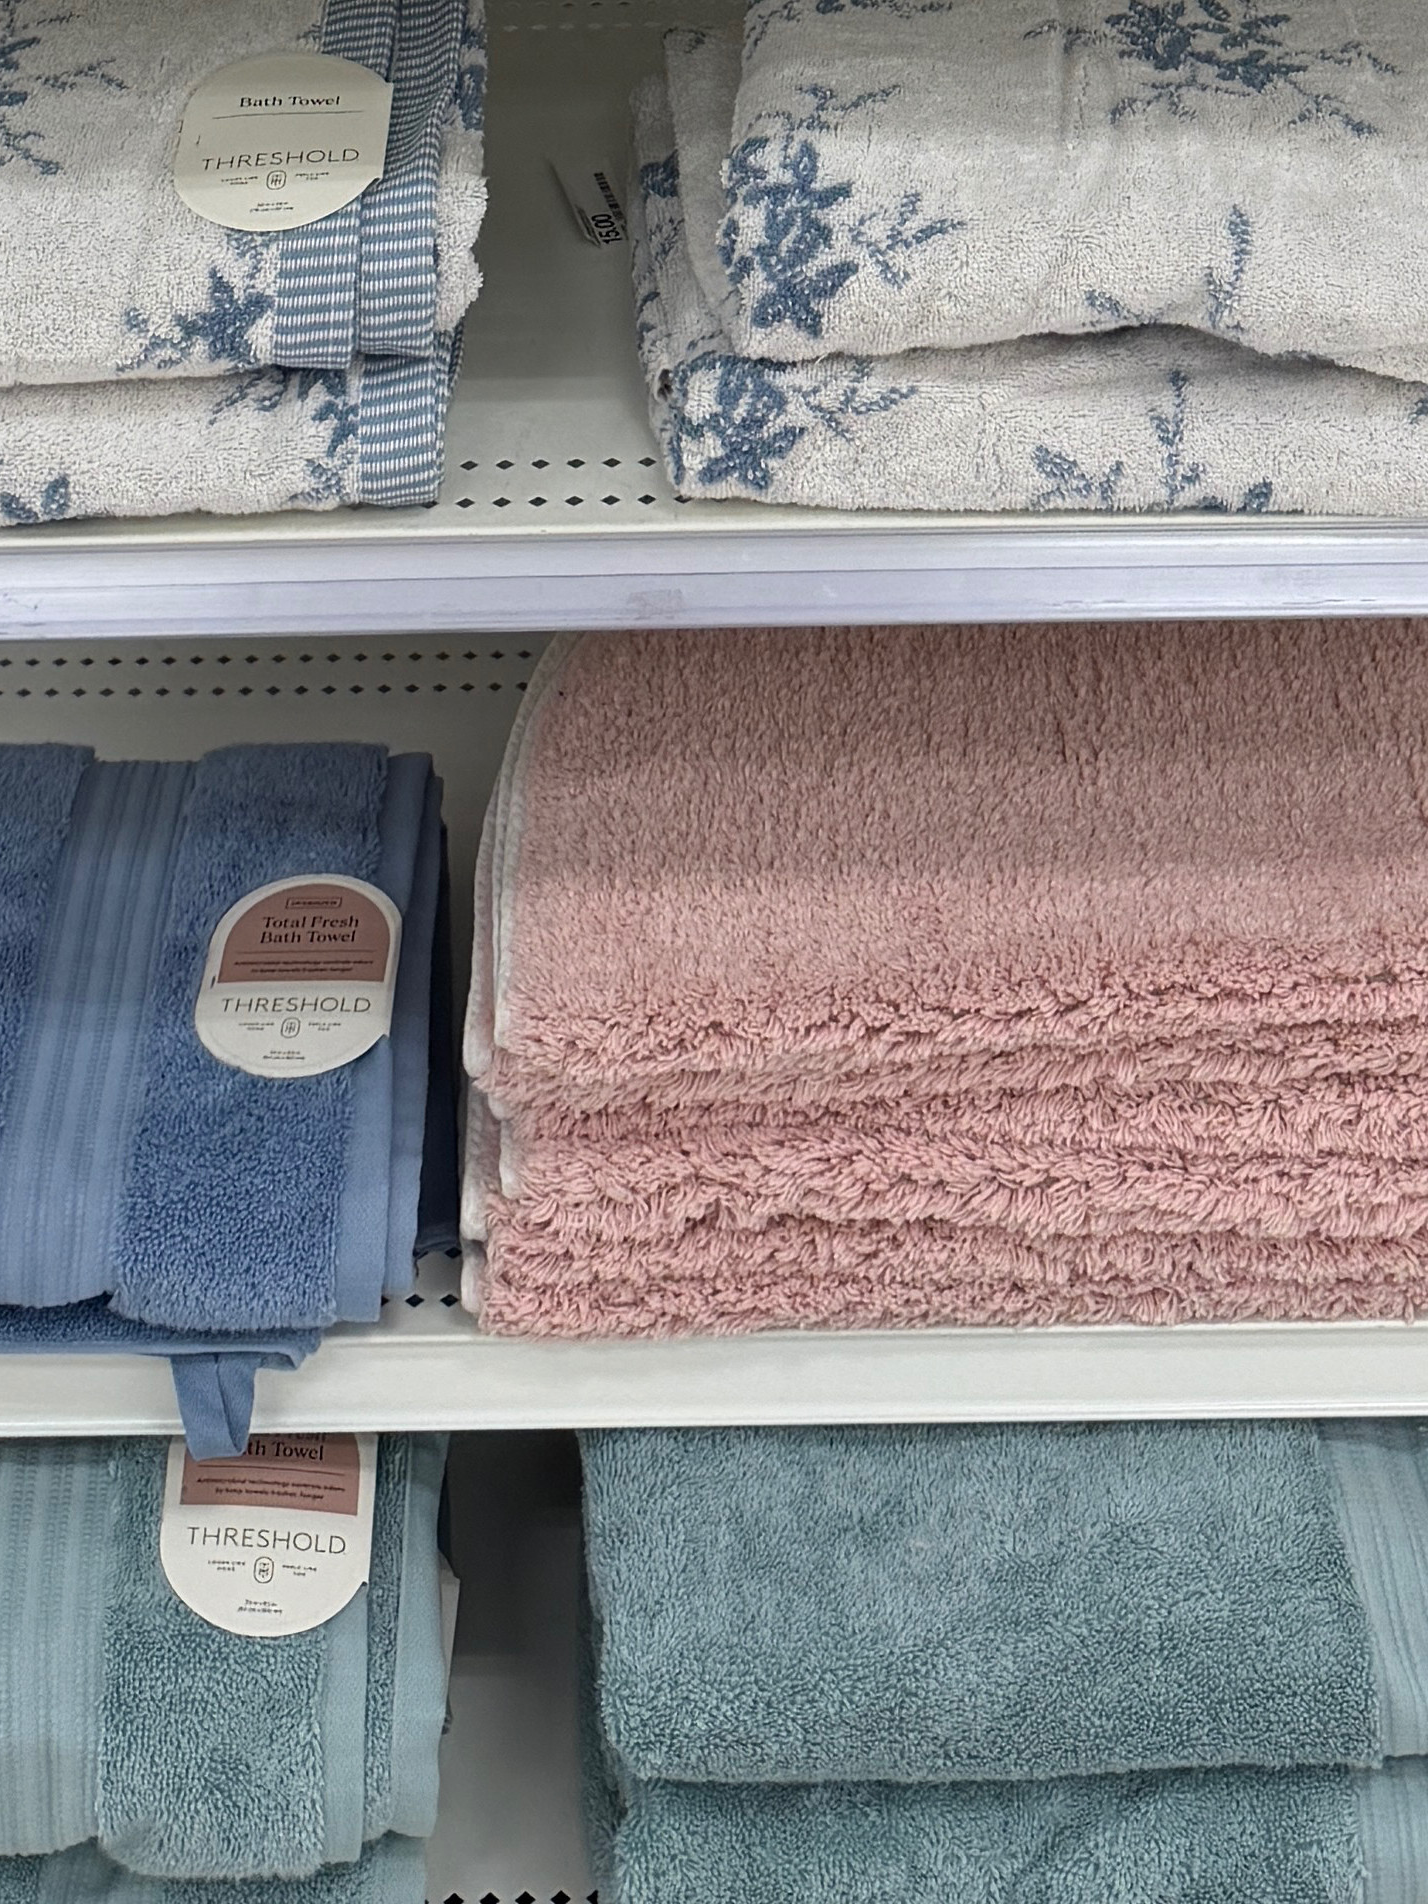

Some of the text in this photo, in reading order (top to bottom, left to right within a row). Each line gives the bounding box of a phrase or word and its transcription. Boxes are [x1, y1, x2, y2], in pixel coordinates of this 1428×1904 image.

[240, 95, 341, 108] Bath Towel
[202, 148, 359, 171] THRESHOLD
[592, 214, 622, 244] 15.00
[263, 915, 359, 929] Total Fresh
[260, 930, 356, 944] Bath Towel
[222, 997, 371, 1013] THRESHOLD
[244, 1440, 323, 1461] th Towel
[187, 1526, 346, 1555] THRESHOLD
